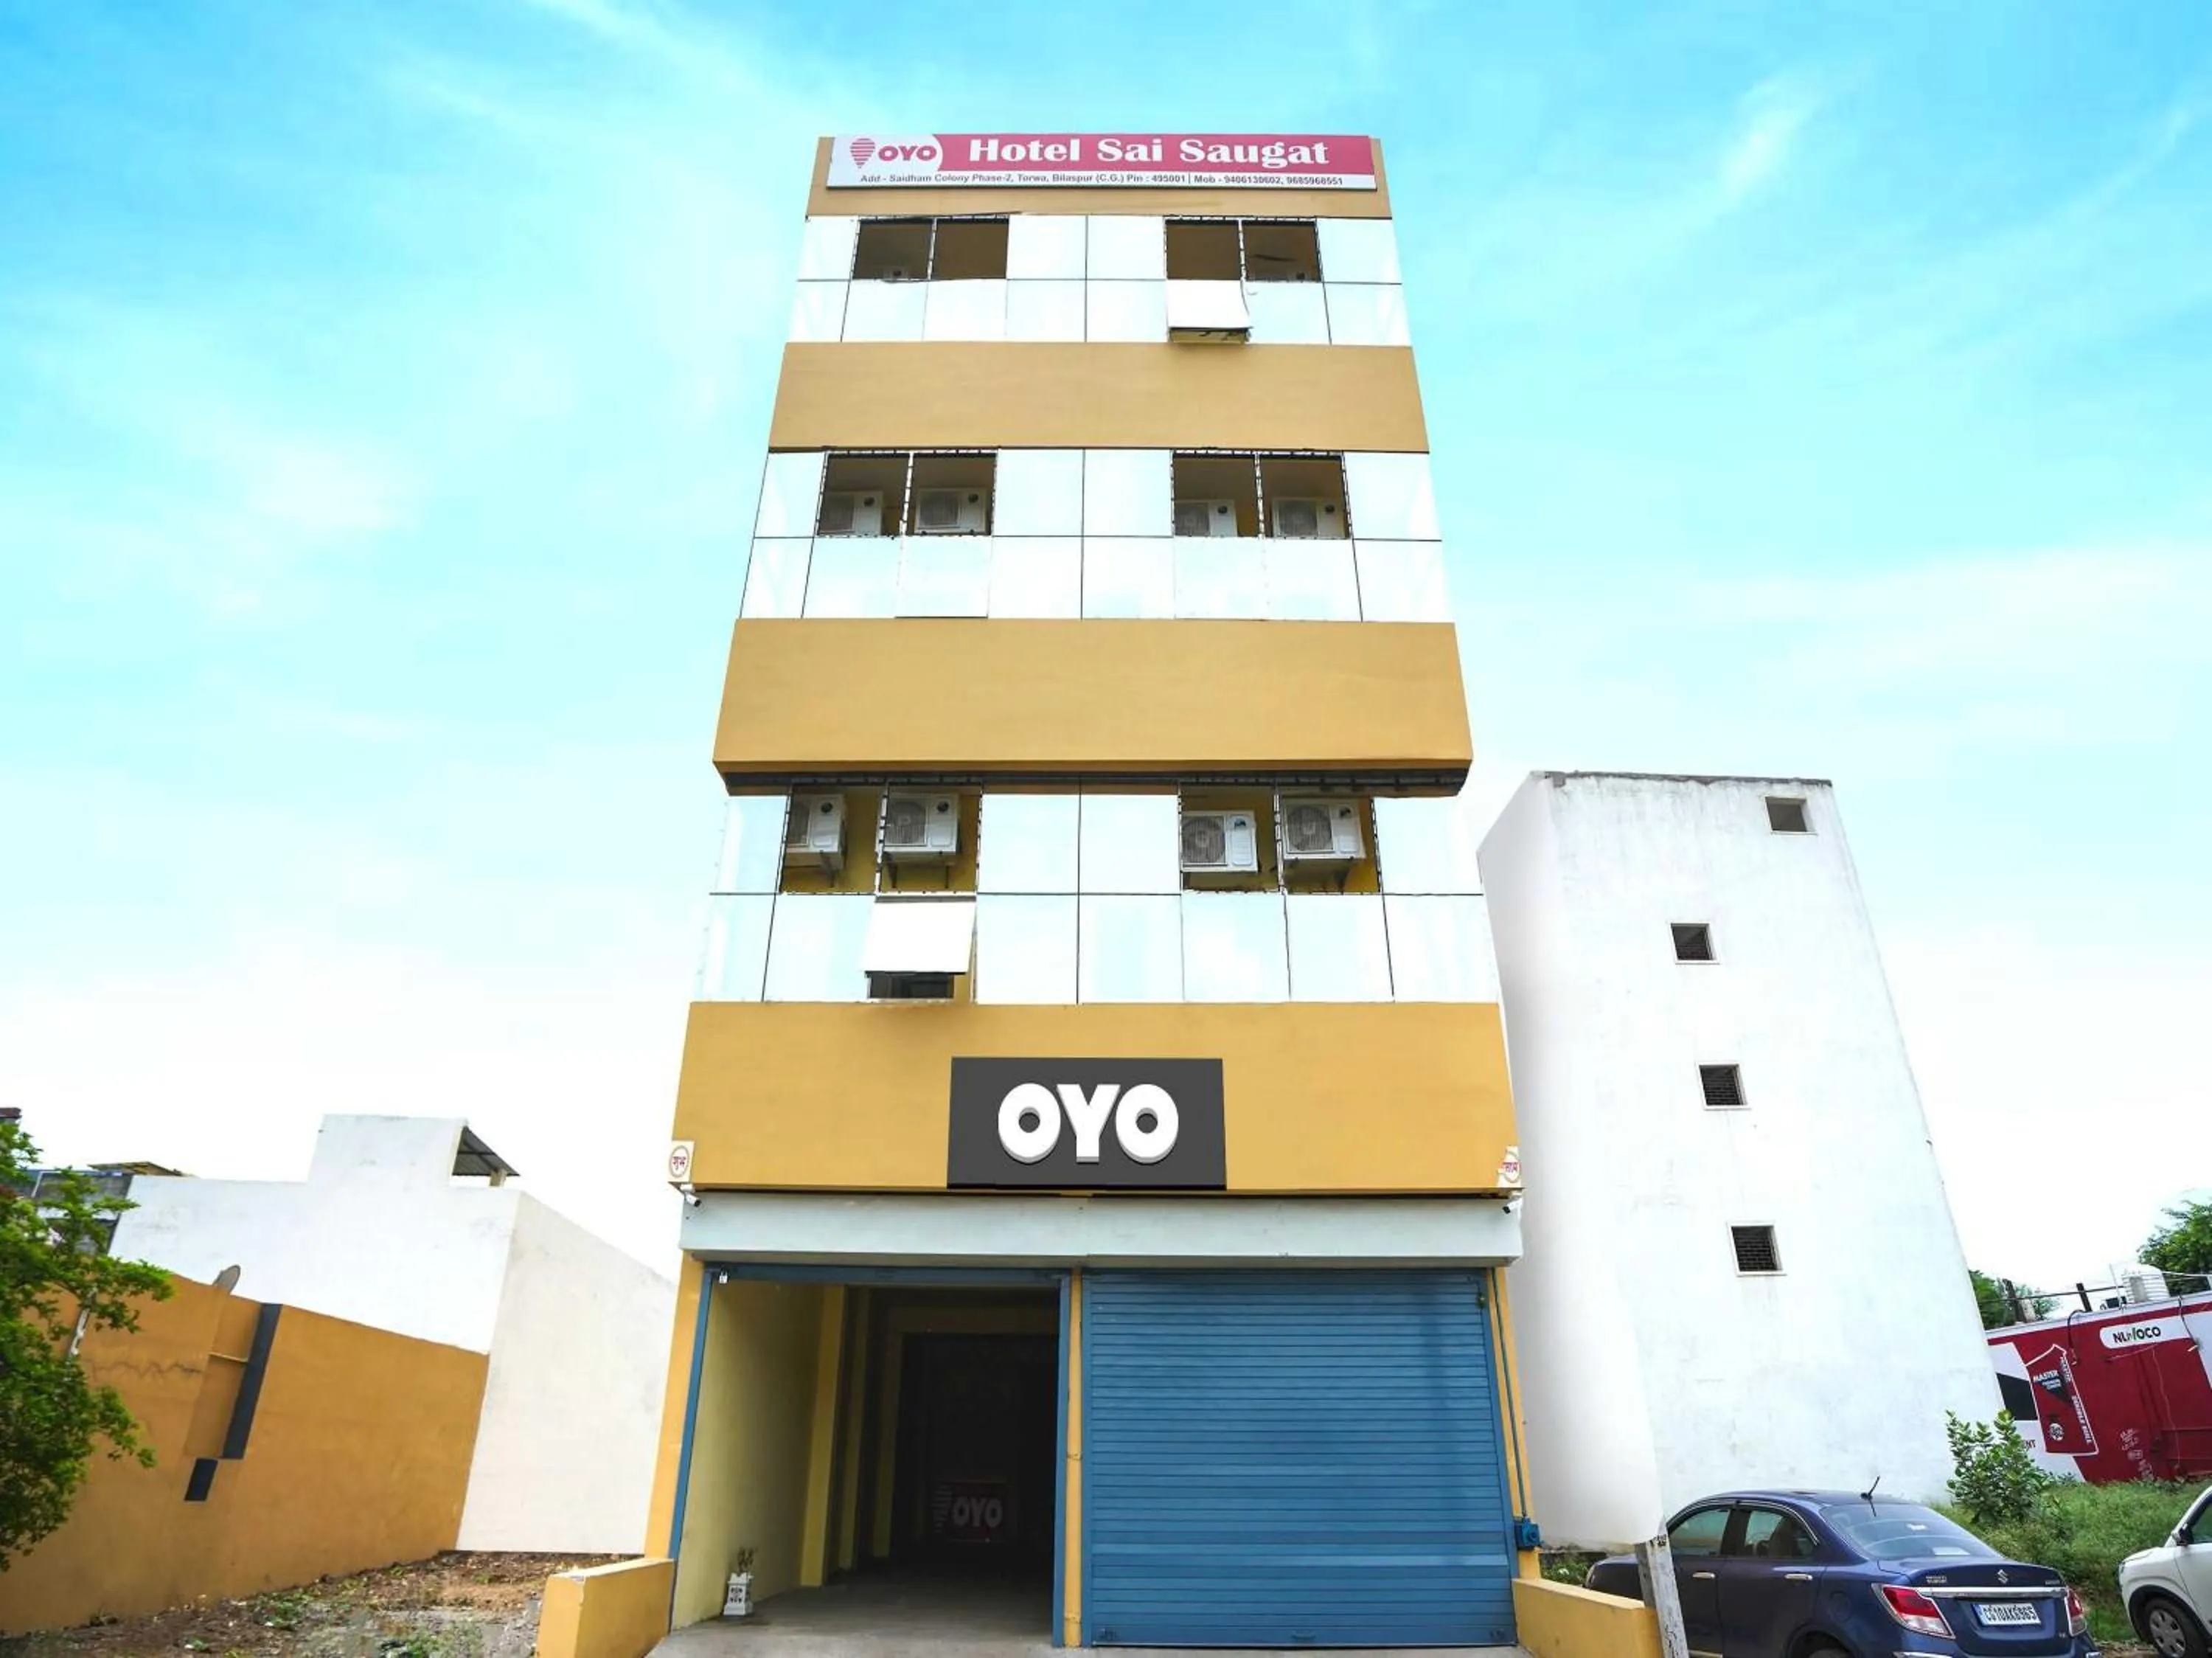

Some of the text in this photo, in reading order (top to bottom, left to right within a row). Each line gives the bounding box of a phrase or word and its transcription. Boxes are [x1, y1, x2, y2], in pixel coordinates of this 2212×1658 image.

[877, 145, 938, 162] OYO
[969, 139, 1329, 169] Hotel Sai Saugat
[889, 173, 931, 183] Saidham
[934, 173, 969, 184] Colony
[1052, 173, 1092, 184] Bilaspur
[1127, 174, 1143, 183] Pin
[1194, 176, 1216, 184] Mob
[998, 1082, 1180, 1165] OYO
[952, 1496, 1004, 1528] OYO
